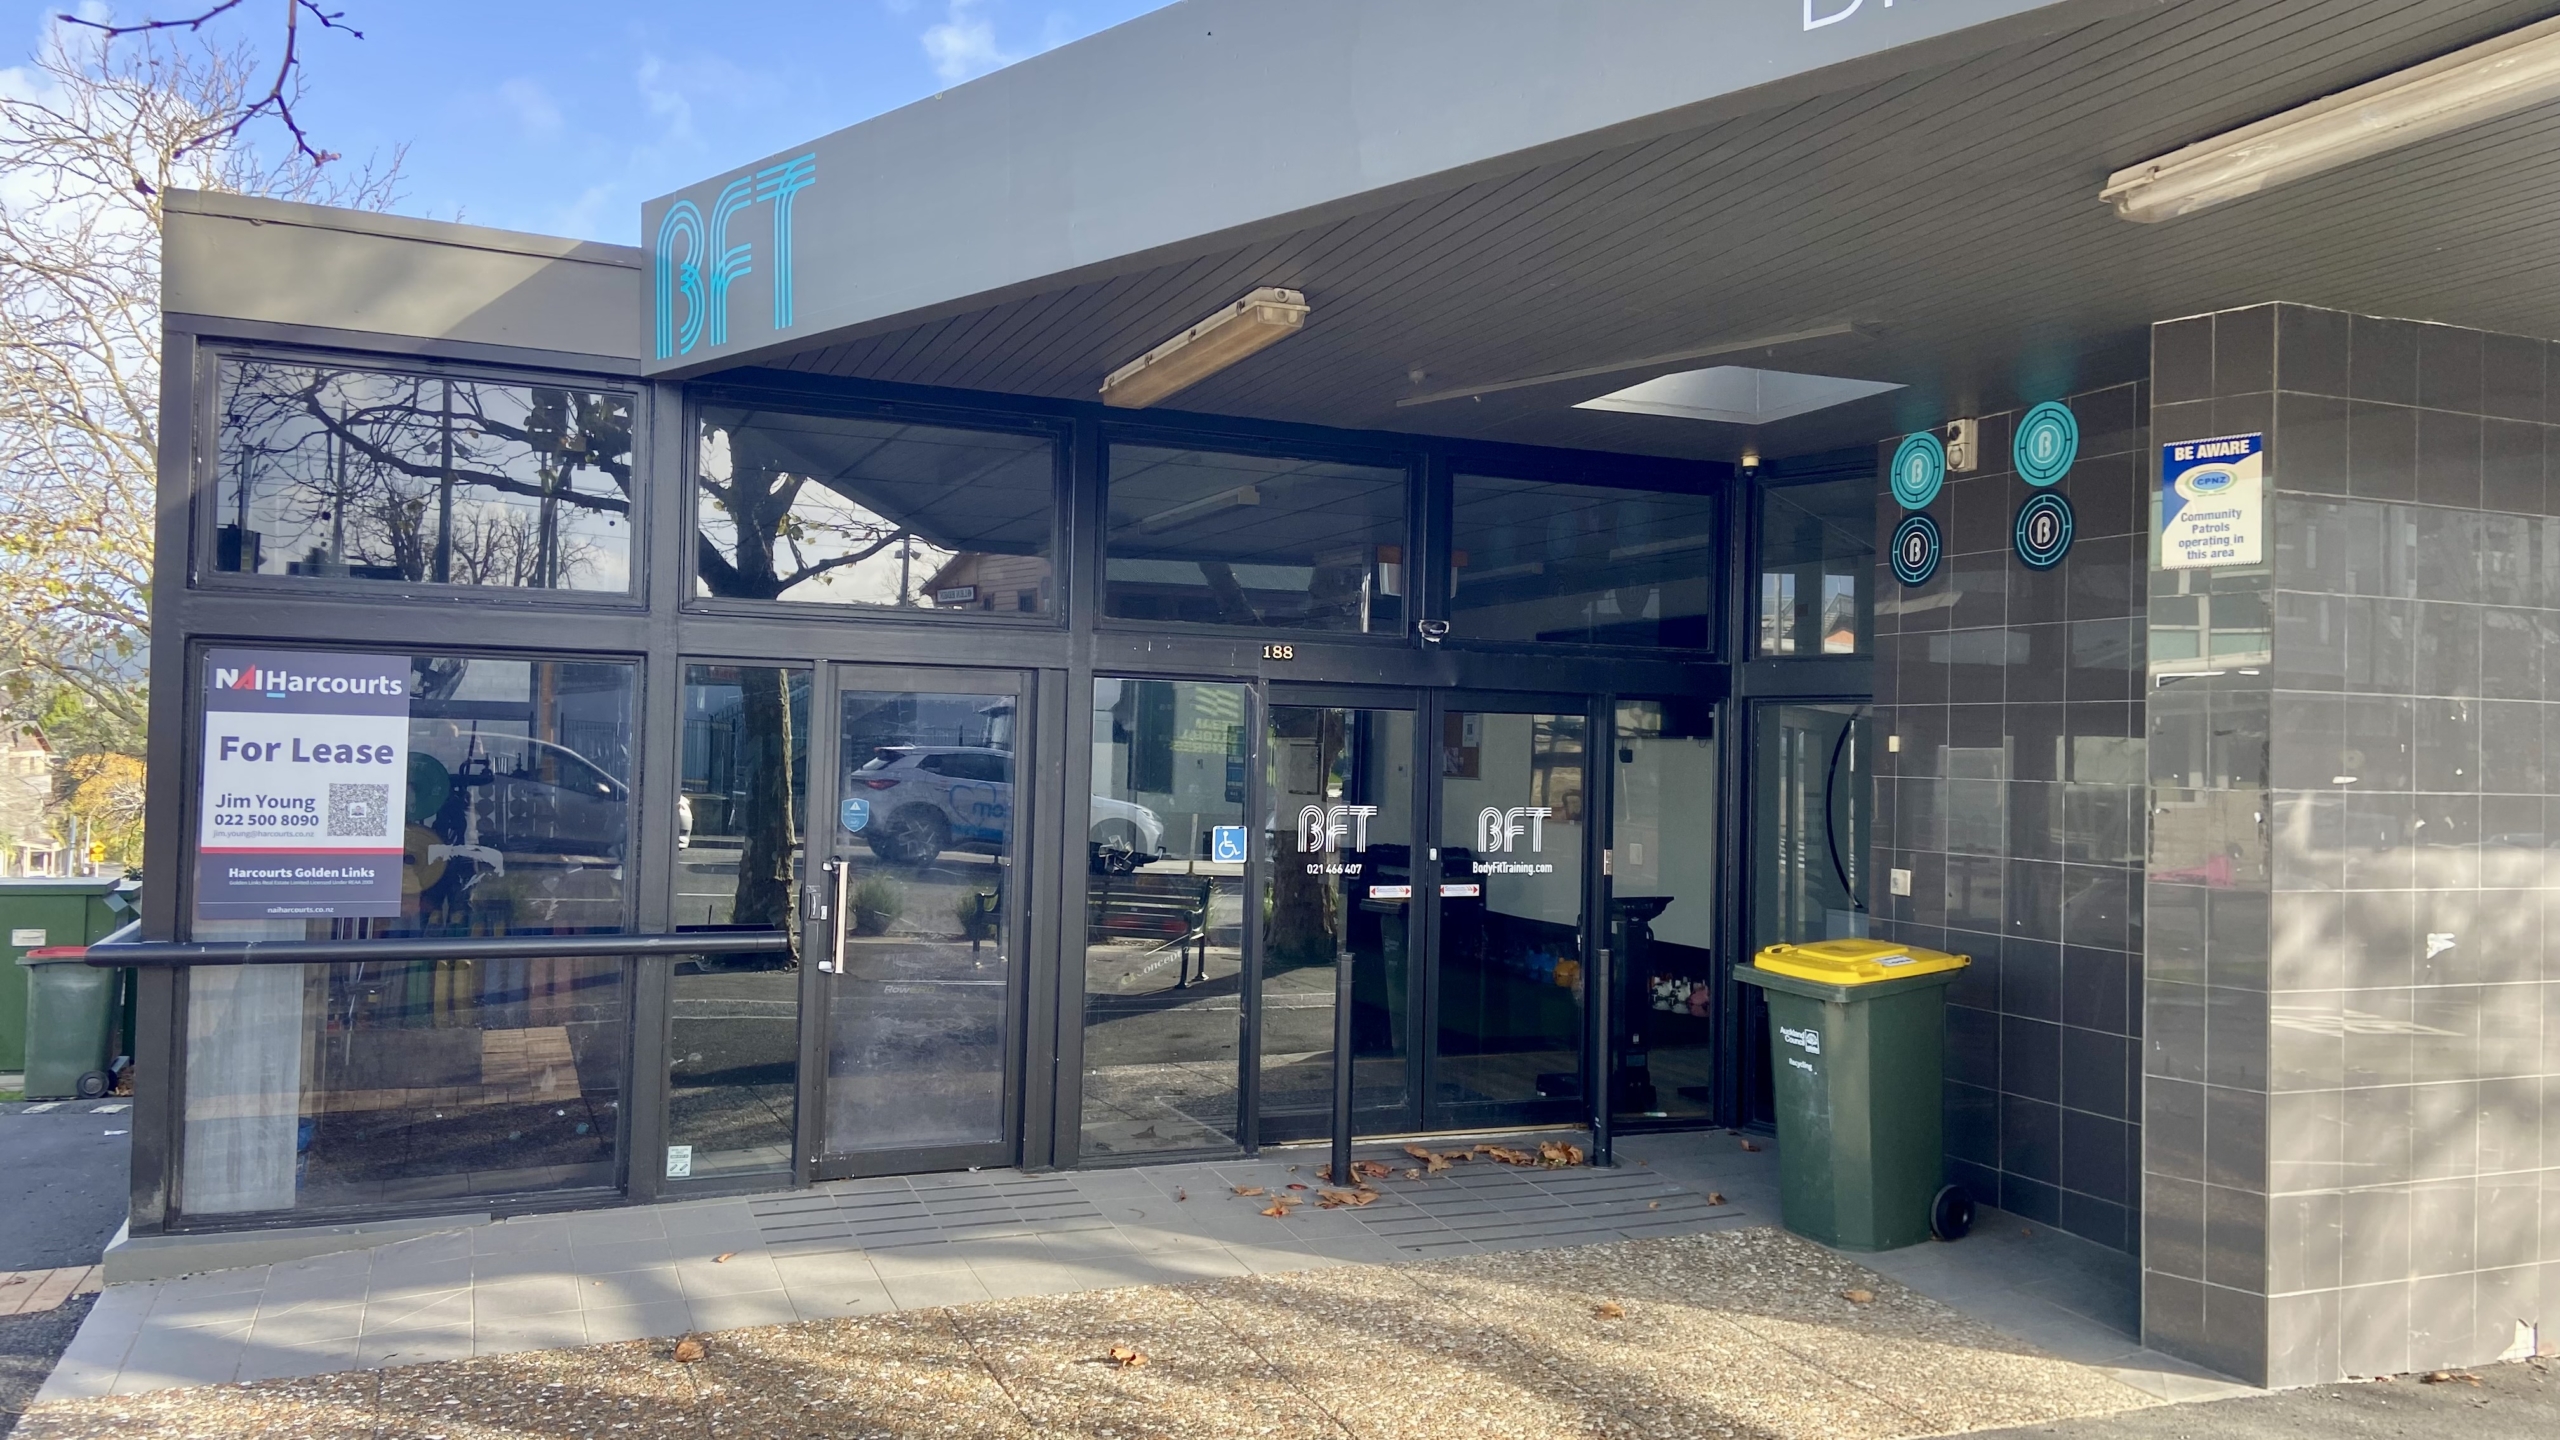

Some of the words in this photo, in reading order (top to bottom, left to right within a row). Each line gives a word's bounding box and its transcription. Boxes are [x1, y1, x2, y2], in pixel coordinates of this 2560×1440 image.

[656, 152, 816, 361] BFT
[2174, 445, 2194, 461] BE
[2196, 439, 2250, 459] AWARE
[2196, 476, 2227, 486] CPNZ
[2181, 508, 2242, 522] Community
[2192, 523, 2230, 534] Patrols
[2178, 536, 2230, 549] operating
[2234, 534, 2244, 544] in
[2187, 550, 2207, 560] this
[2210, 548, 2235, 558] area
[1262, 645, 1294, 660] 188
[219, 735, 281, 762] For
[291, 737, 394, 765] Lease
[215, 793, 251, 809] Jim
[256, 794, 316, 813] Young
[214, 813, 244, 826] 022
[247, 814, 277, 826] 500
[281, 814, 319, 827] 8090
[212, 829, 315, 839] jim.young@harcourts.co.nz
[1297, 804, 1378, 853] BFT
[1477, 806, 1552, 853] BFT
[228, 867, 293, 878] Harcourts
[294, 867, 340, 878] Golden
[341, 866, 375, 878] Links
[1306, 863, 1323, 875] 021
[1325, 863, 1343, 875] 466
[1344, 863, 1362, 875] 407
[1472, 861, 1553, 876] BodyFitTraining.com
[267, 906, 335, 914] naiharcourts.co.nz
[1780, 1026, 1805, 1039] Auckland
